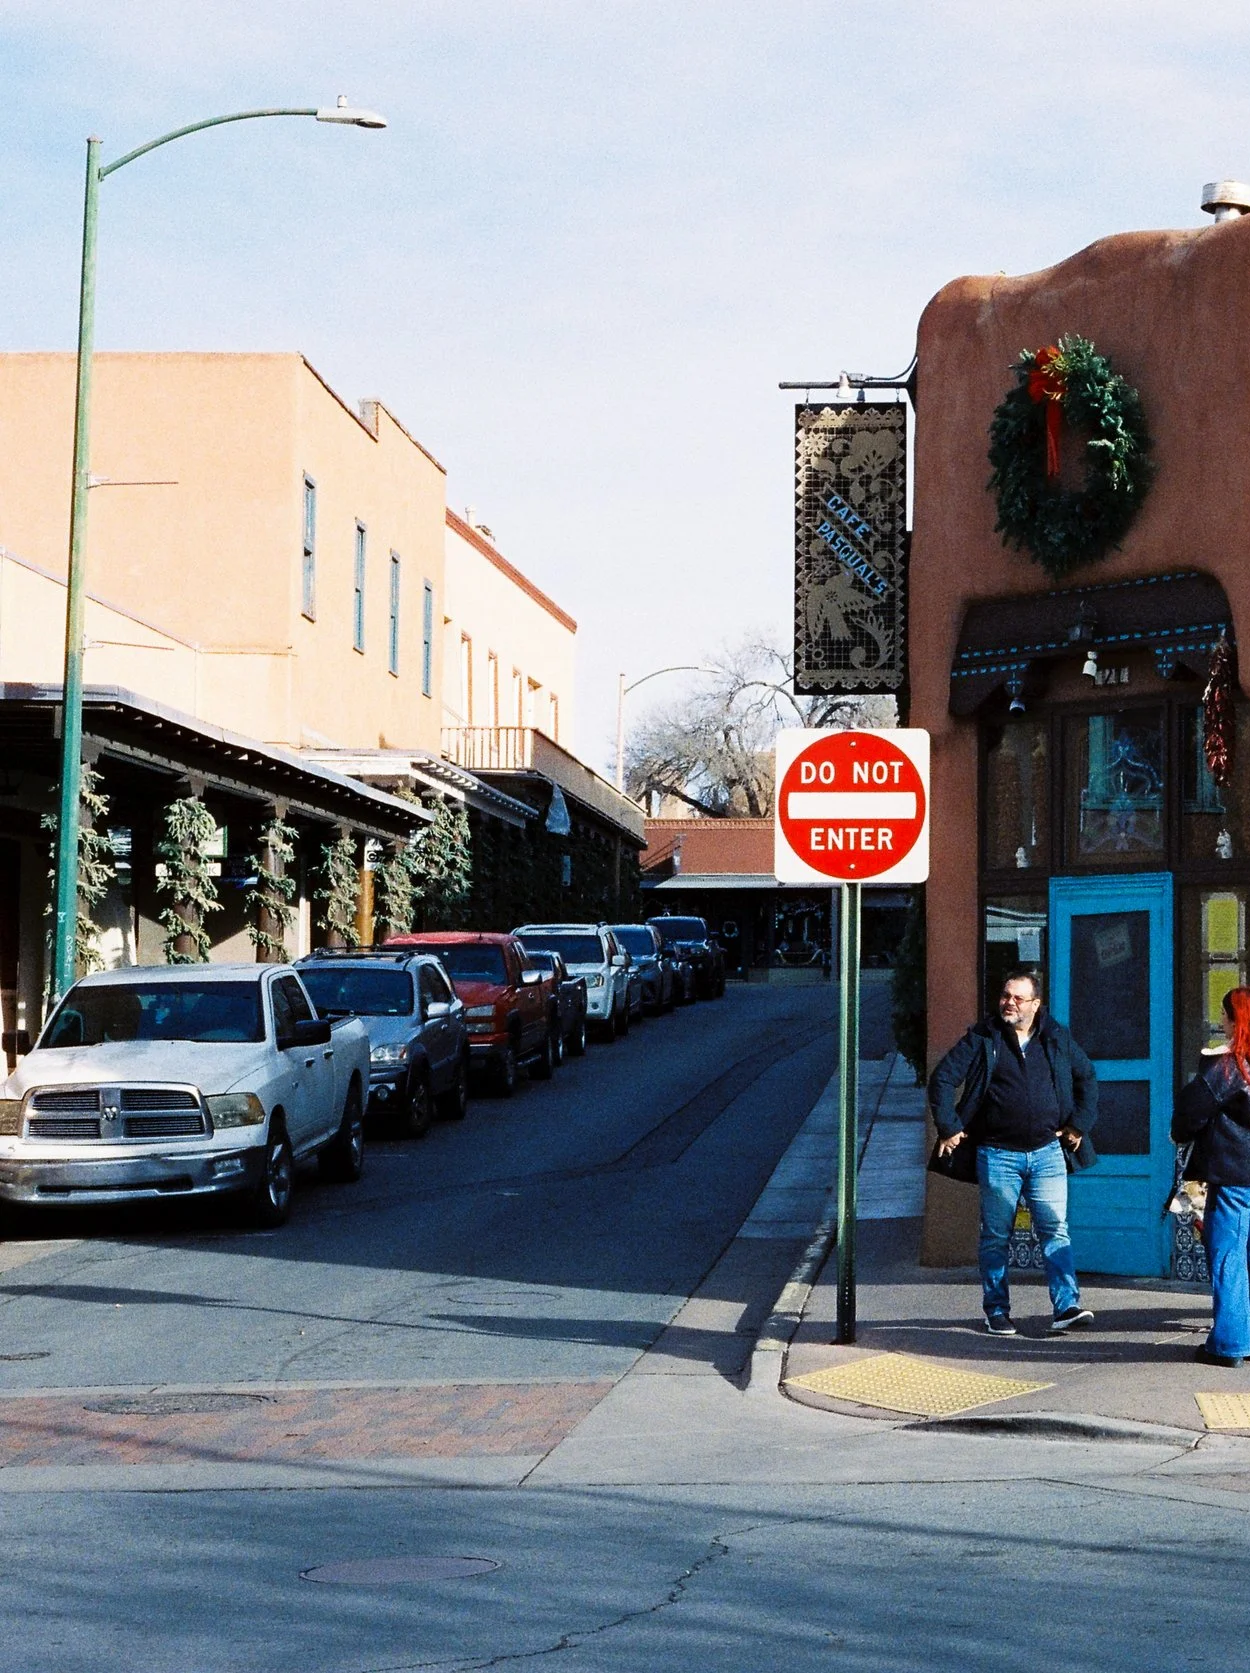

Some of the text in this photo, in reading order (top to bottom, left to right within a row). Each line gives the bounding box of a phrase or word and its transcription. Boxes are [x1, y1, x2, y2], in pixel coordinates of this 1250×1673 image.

[827, 495, 870, 538] CAFE
[816, 521, 888, 594] PASQUAL'S
[801, 761, 904, 784] DO NOT
[810, 827, 893, 850] ENTER
